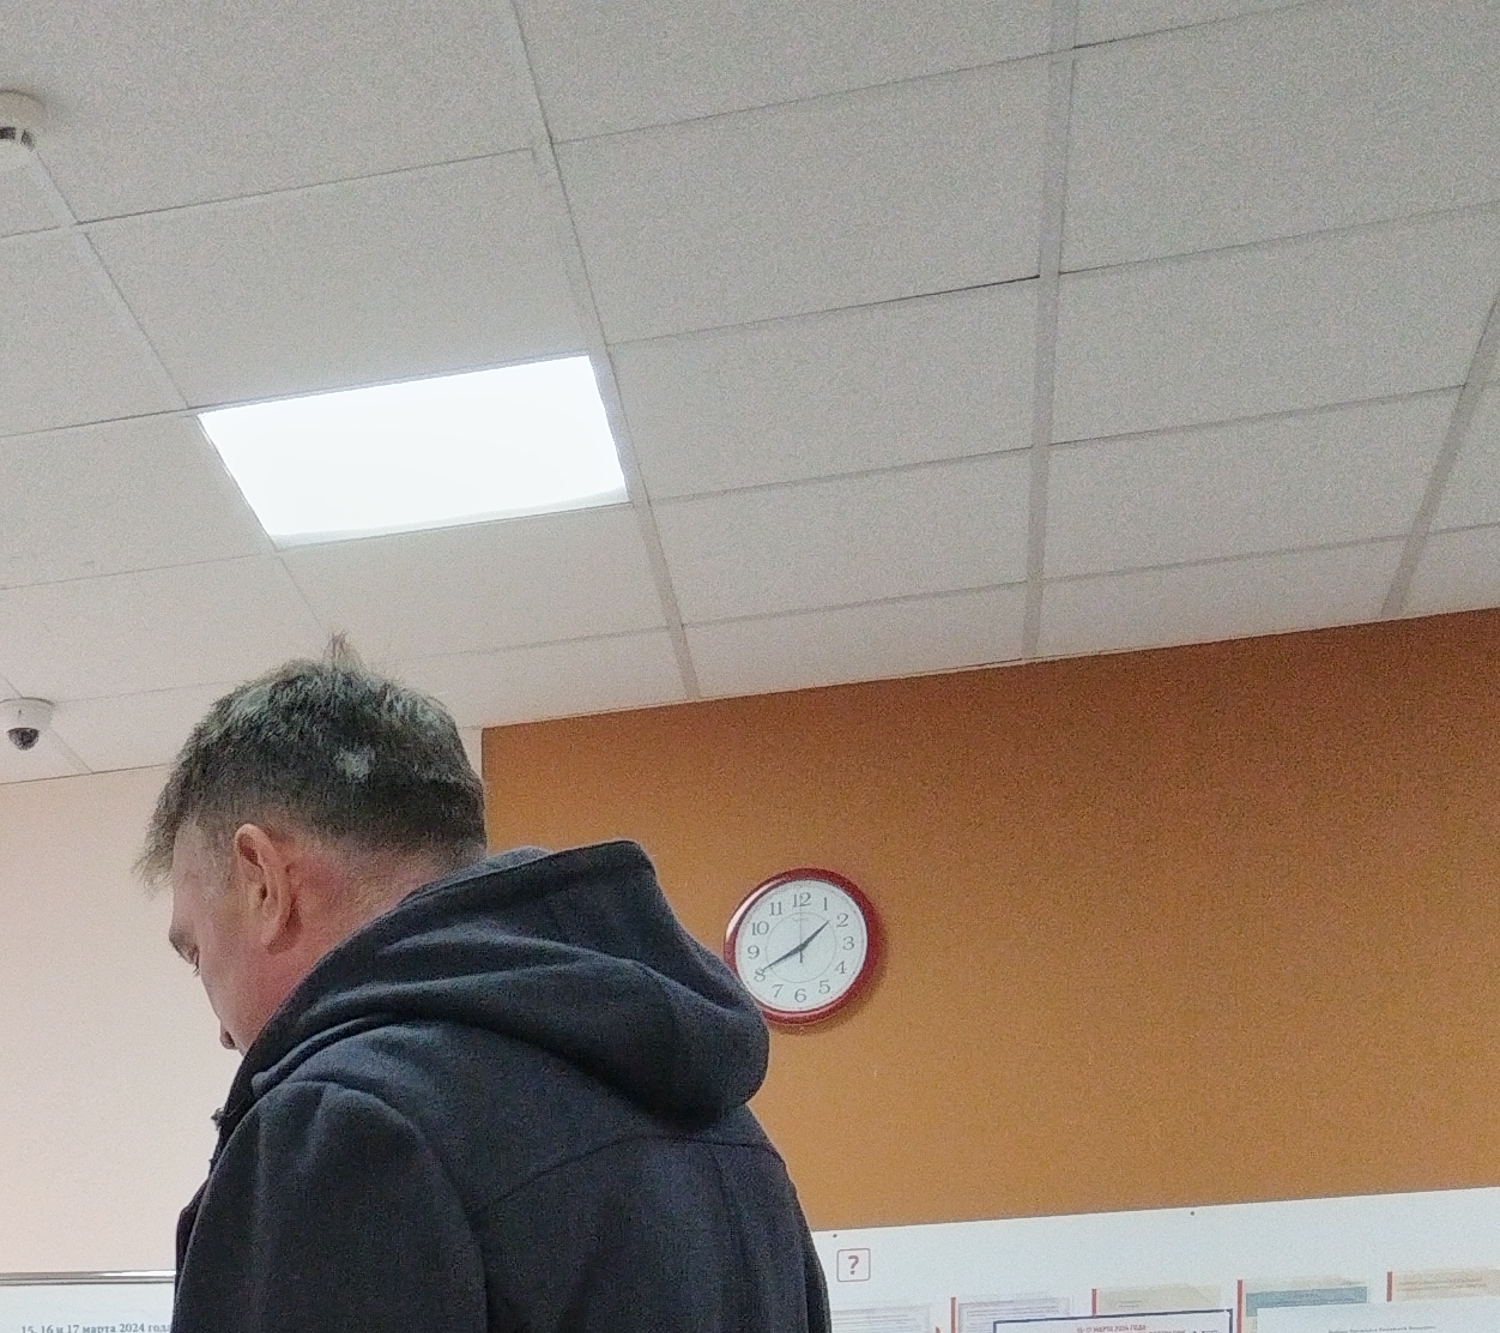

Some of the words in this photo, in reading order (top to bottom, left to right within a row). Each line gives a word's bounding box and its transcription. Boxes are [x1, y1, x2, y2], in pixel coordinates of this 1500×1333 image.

[793, 892, 811, 908] 12
[823, 897, 828, 911] 1
[769, 901, 783, 916] 11
[836, 913, 849, 928] 2
[751, 921, 770, 936] 10
[842, 936, 855, 951] 3
[747, 945, 760, 960] 9
[834, 961, 847, 974] 4
[771, 984, 784, 998] 7
[818, 979, 831, 994] 5
[794, 988, 807, 1003] 6
[67, 1324, 80, 1333] 17
[119, 1323, 145, 1333] 2024
